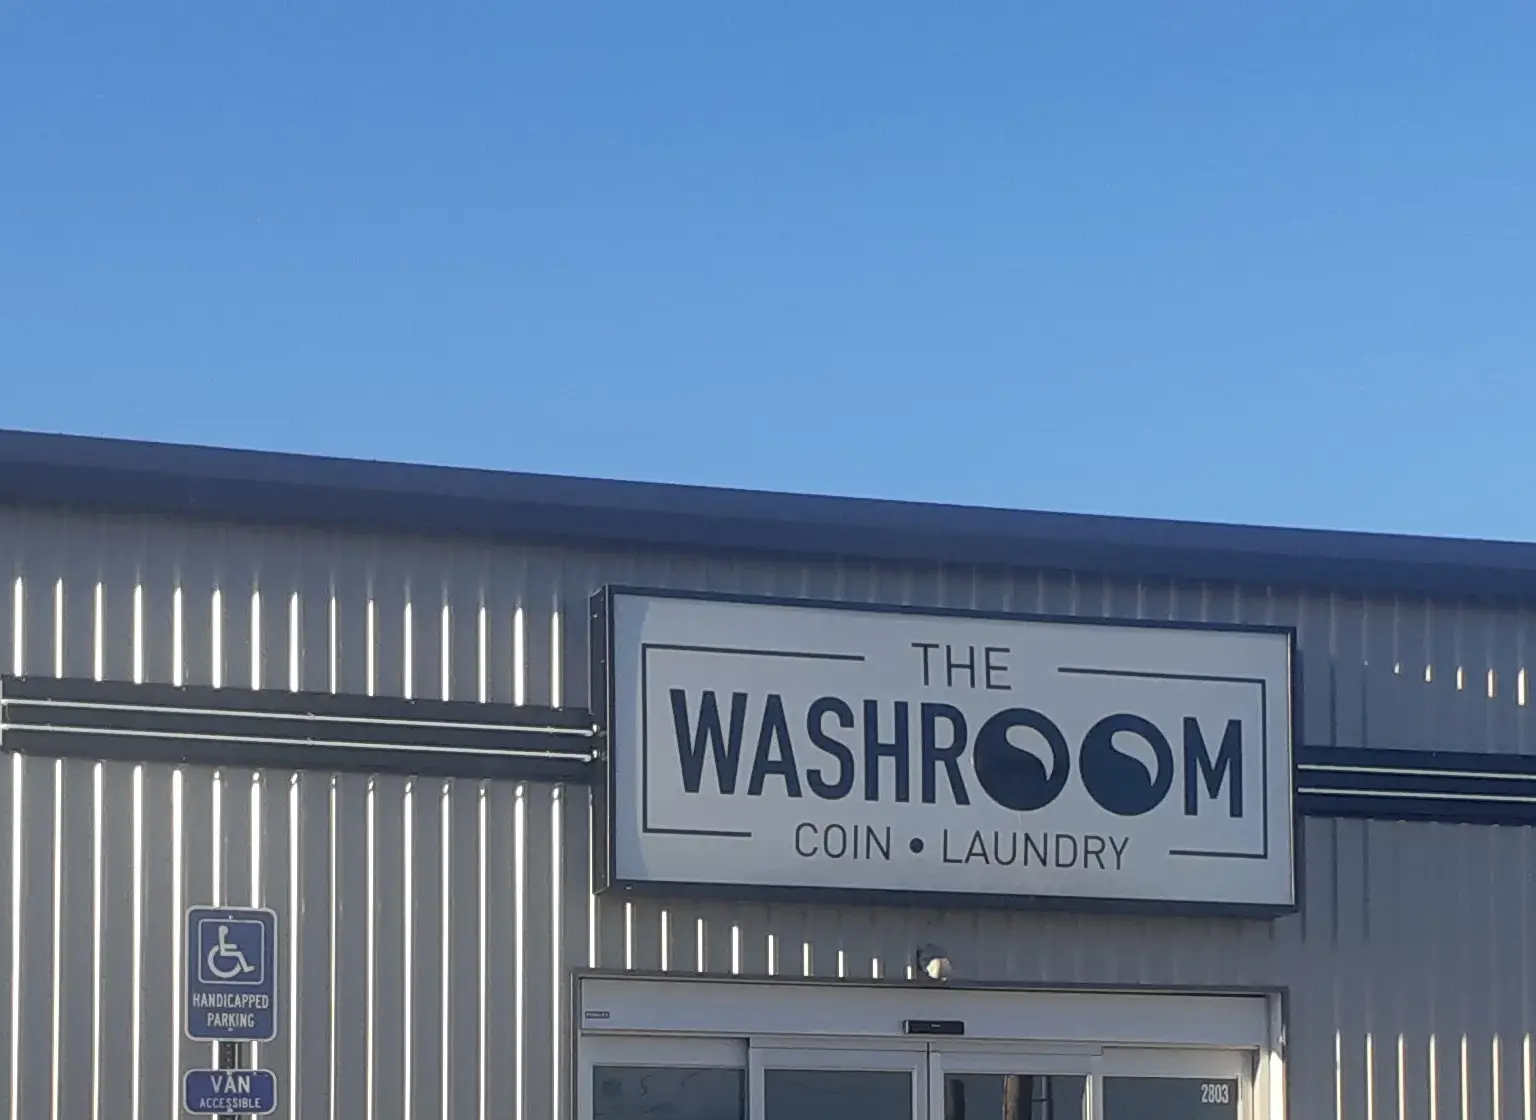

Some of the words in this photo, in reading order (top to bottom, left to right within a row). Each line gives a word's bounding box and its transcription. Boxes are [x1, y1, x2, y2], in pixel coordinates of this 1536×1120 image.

[911, 641, 1012, 690] THE
[668, 687, 1244, 818] WASHROOM
[794, 822, 892, 862] COIN
[941, 828, 1130, 871] LAUNDRY
[192, 991, 270, 1010] HANDICAPPED
[206, 1012, 256, 1029] PARKING
[209, 1074, 251, 1094] VAN
[1200, 1083, 1230, 1104] 2803
[199, 1096, 262, 1109] ACCESSIBLE
